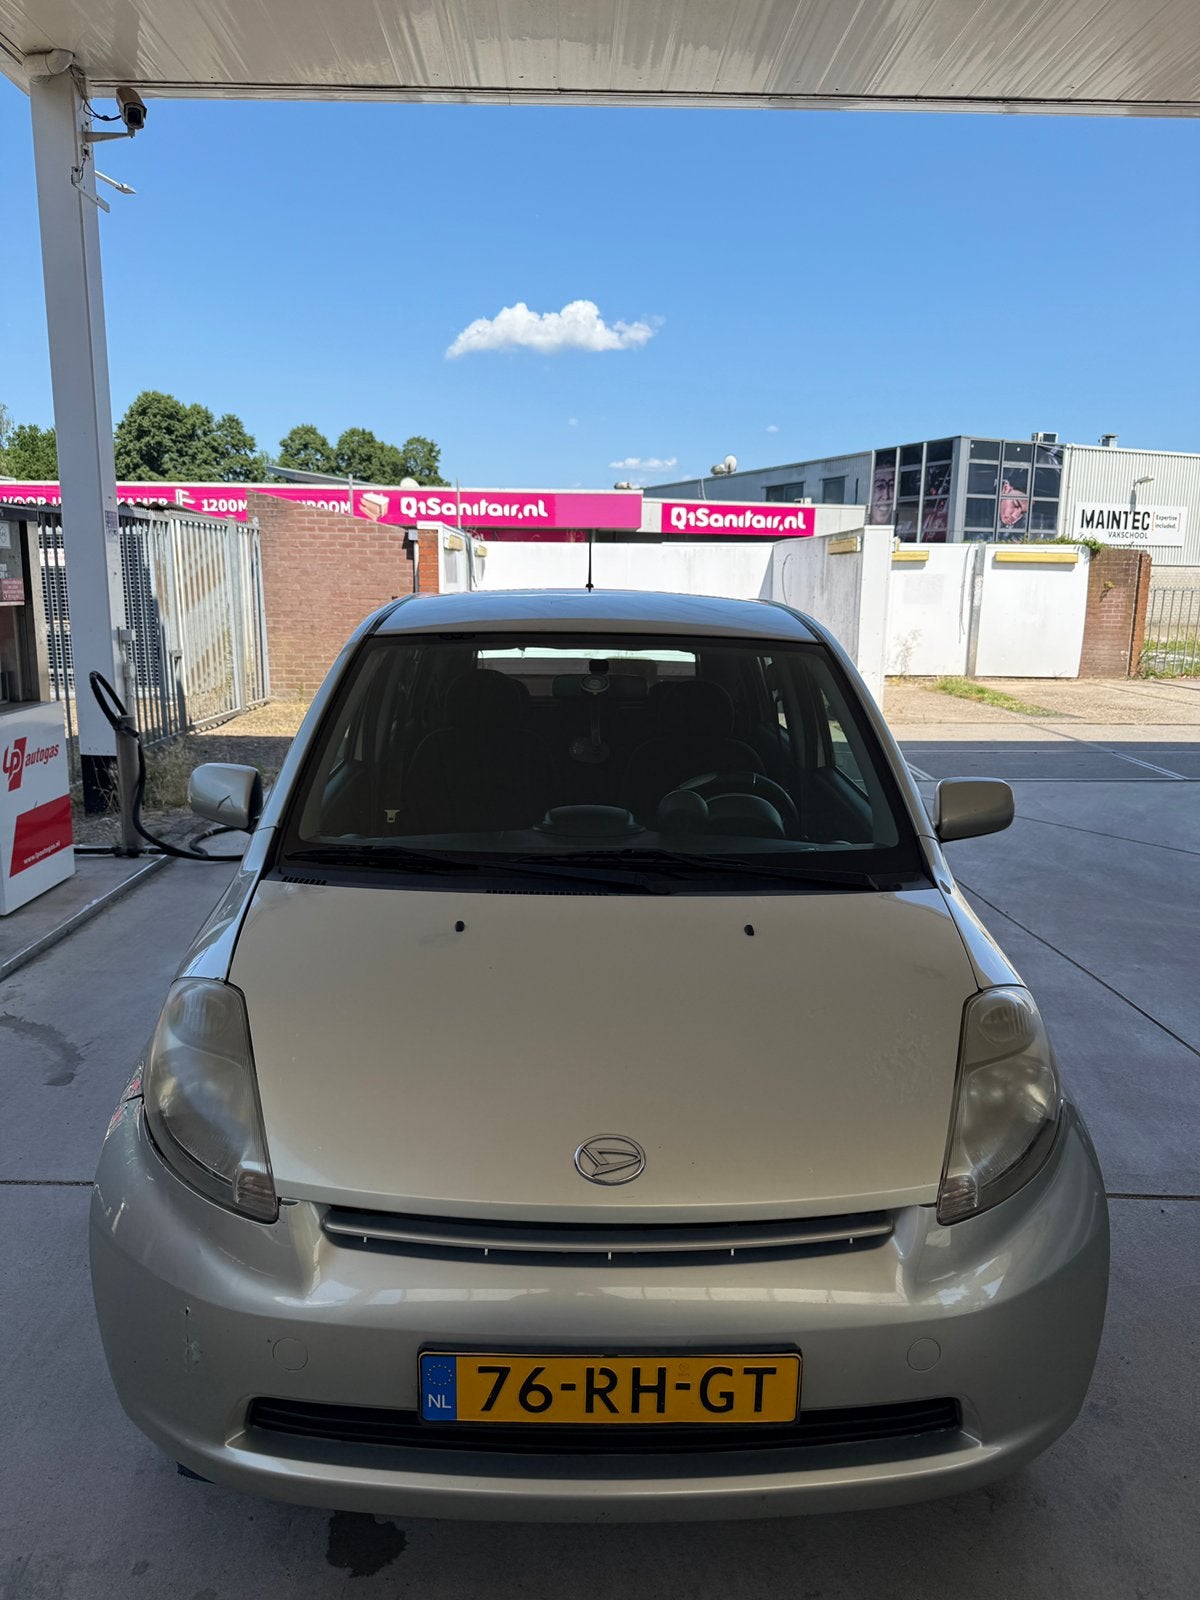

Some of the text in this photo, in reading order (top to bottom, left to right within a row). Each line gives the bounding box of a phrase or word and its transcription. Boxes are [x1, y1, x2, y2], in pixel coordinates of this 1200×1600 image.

[1080, 508, 1151, 531] MAINTEC
[1108, 530, 1149, 540] VAKSCHOOL
[25, 744, 60, 768] autogas
[427, 1393, 452, 1409] NL
[477, 1365, 778, 1414] 76-RH-GT
